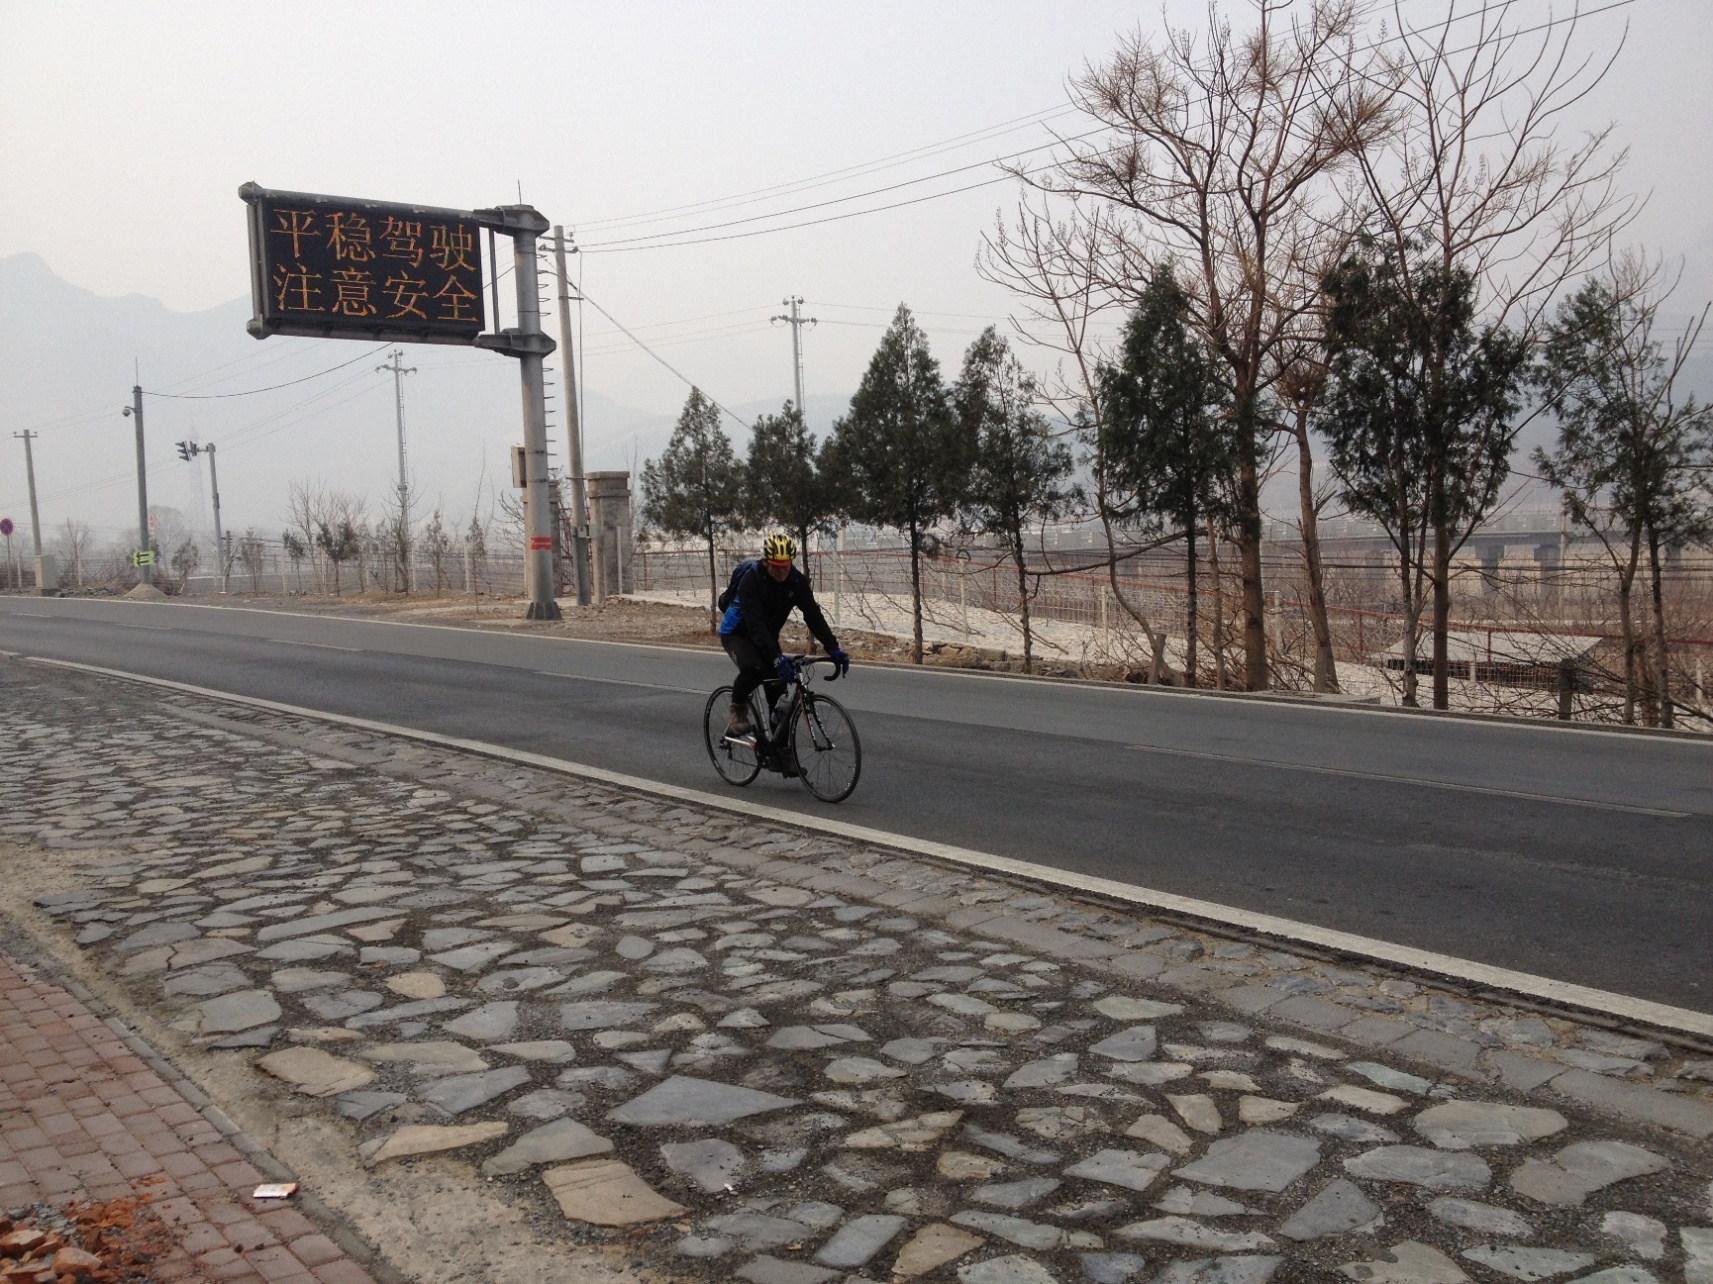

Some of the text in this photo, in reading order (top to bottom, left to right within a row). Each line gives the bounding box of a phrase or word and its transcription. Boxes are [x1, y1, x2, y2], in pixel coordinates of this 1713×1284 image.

[270, 208, 476, 271] 平稳驾驶
[272, 263, 479, 321] 注意安全
